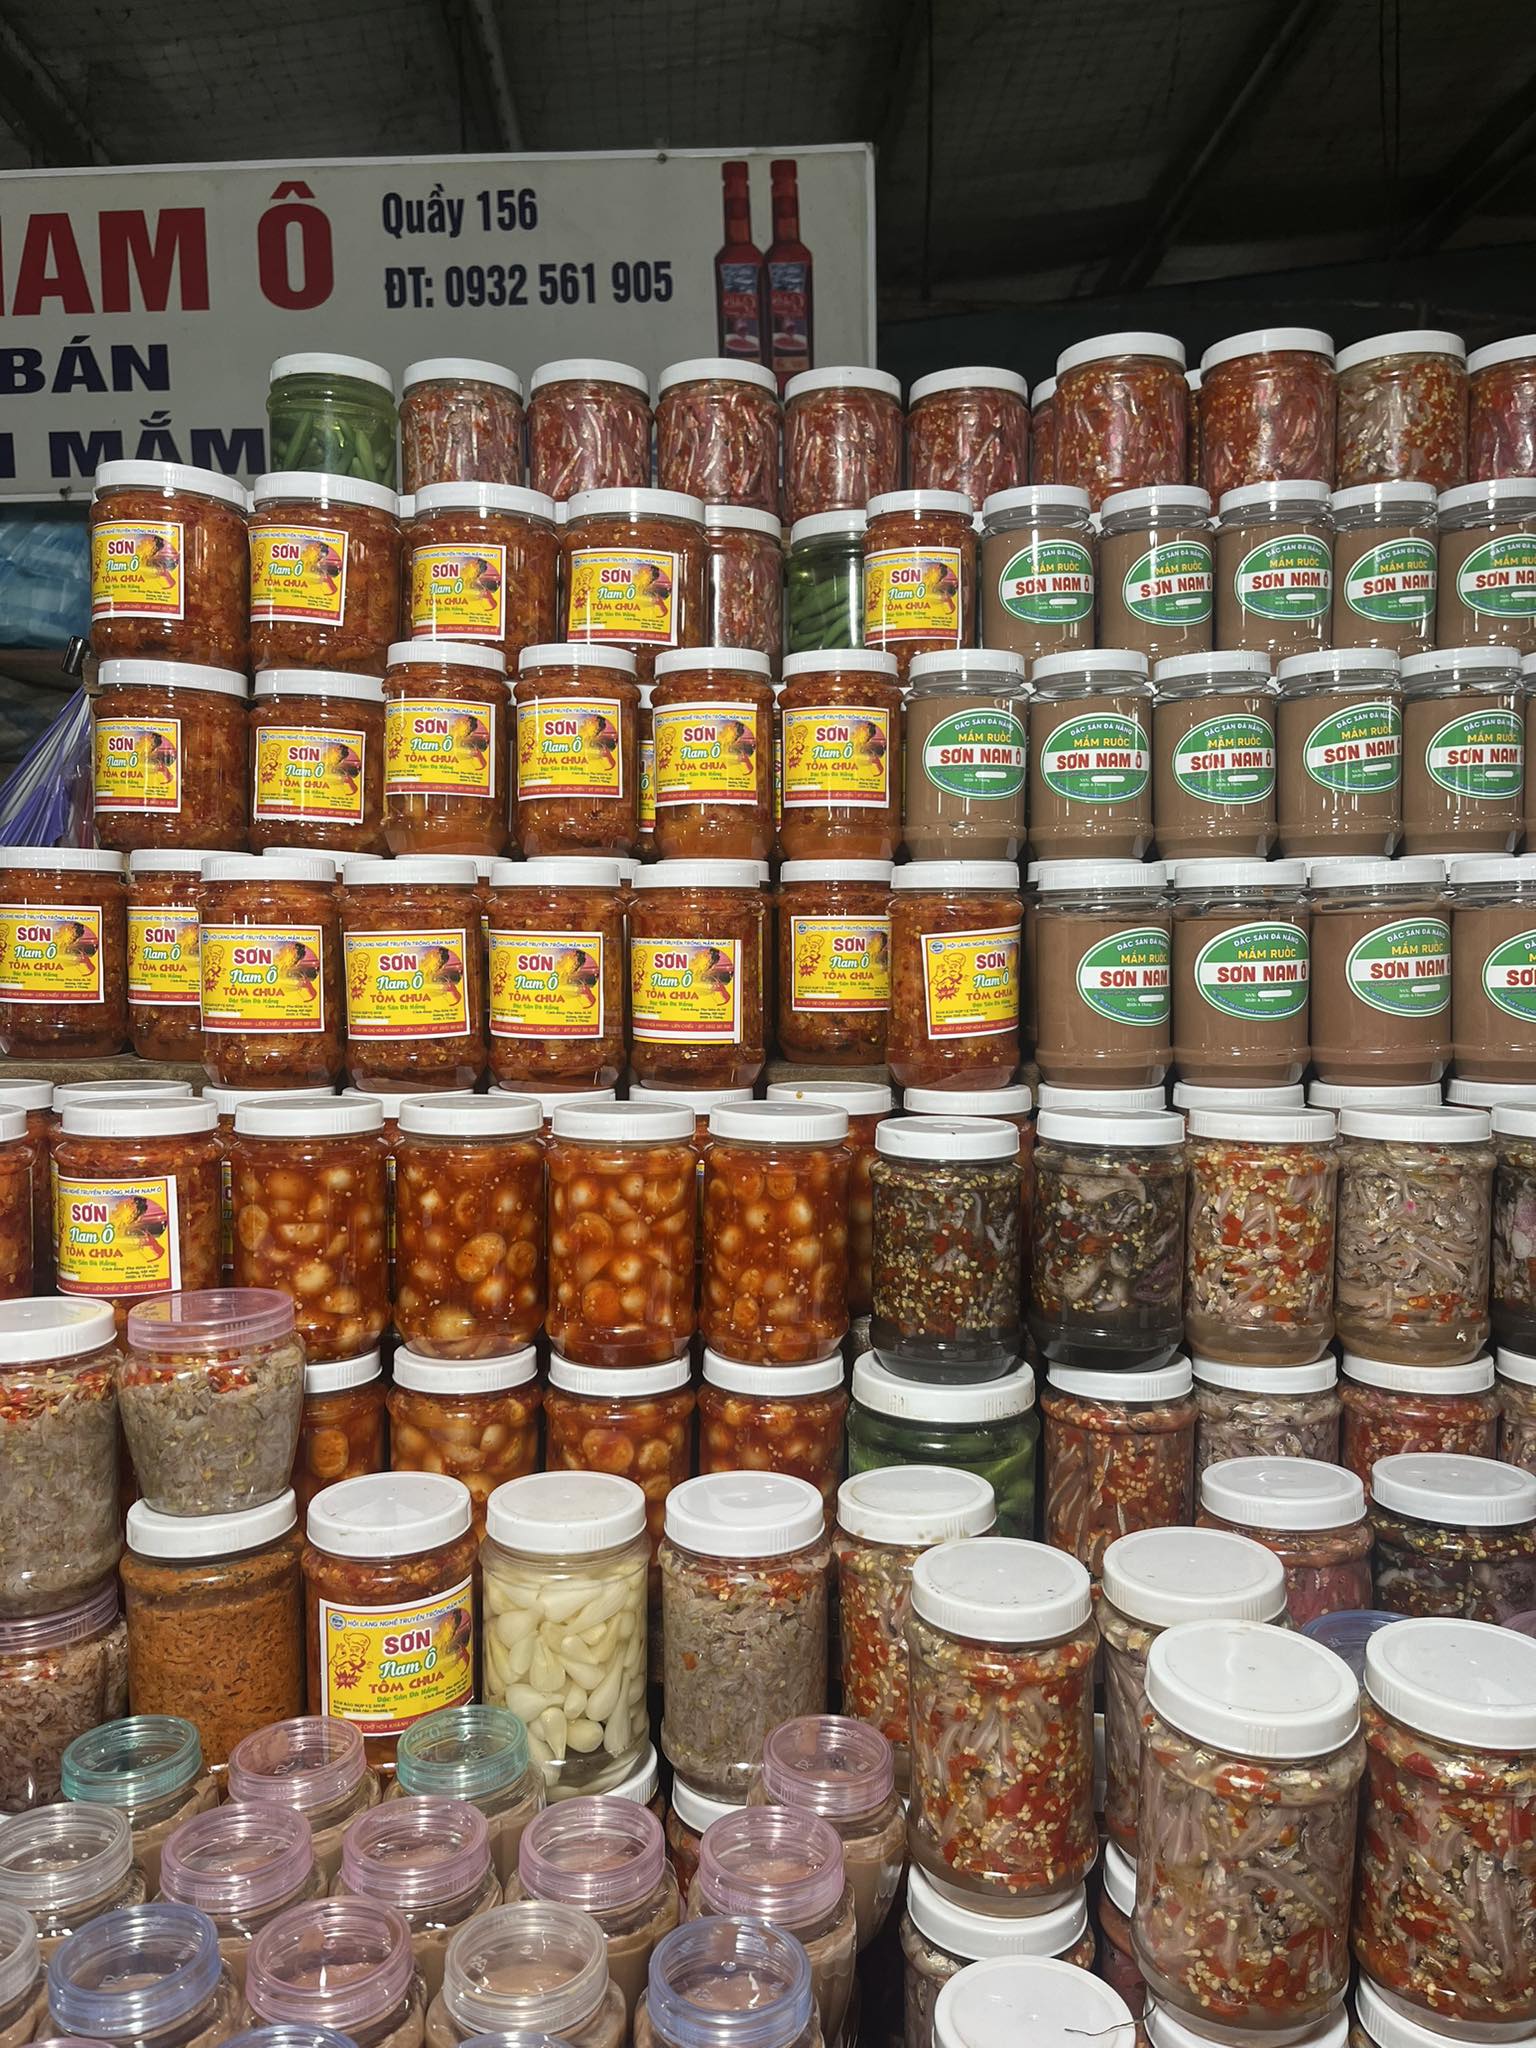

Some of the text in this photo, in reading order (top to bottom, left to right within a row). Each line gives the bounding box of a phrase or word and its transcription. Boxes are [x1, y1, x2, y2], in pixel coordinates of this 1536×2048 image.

[382, 184, 538, 239] Quầy 156
[0, 180, 334, 316] AM Ô
[385, 261, 673, 308] ĐT: 0932 561 905
[0, 336, 170, 394] BÁN
[49, 411, 267, 478] MẮM
[108, 540, 134, 555] SƠN
[272, 544, 299, 559] SƠN
[106, 560, 126, 572] Nam
[270, 563, 290, 576] Nam
[432, 564, 458, 578] SƠN
[601, 569, 630, 583] SƠN
[891, 568, 920, 584] SƠN
[1252, 572, 1284, 589] SƠN
[1291, 572, 1319, 586] NAM
[1476, 571, 1509, 588] SƠN
[430, 582, 450, 594] Nam
[1016, 580, 1046, 595] SƠN
[1053, 577, 1081, 592] NAM
[1141, 575, 1204, 597] SƠN NAM
[1363, 576, 1428, 594] SƠN NAM
[598, 587, 624, 599] Nam
[888, 587, 912, 599] Nam
[414, 719, 447, 733] SƠN
[545, 720, 576, 734] SƠN
[684, 726, 715, 740] SƠN
[816, 726, 848, 741] SƠN
[109, 737, 133, 750] SƠN
[411, 739, 439, 750] Nam
[542, 741, 569, 752] Nam
[289, 747, 320, 761] SƠN
[681, 747, 708, 758] Nam
[813, 746, 840, 758] Nam
[940, 747, 973, 764] SƠN
[980, 748, 1011, 763] NAM
[1325, 740, 1394, 763] SƠN NAM
[1448, 748, 1517, 764] SƠN NAM
[106, 756, 127, 766] Nam
[431, 755, 459, 763] CHUA
[561, 756, 588, 764] CHUA
[700, 762, 726, 770] CHUA
[831, 762, 858, 770] CHUA
[1057, 752, 1090, 770] SƠN
[1096, 753, 1130, 768] NAM
[1191, 754, 1224, 770] SƠN
[1232, 751, 1262, 767] NAM
[286, 764, 311, 776] Nam
[18, 926, 50, 941] SƠN
[146, 928, 175, 942] SƠN
[15, 946, 42, 958] Nam
[834, 938, 864, 952] SƠN
[143, 948, 168, 960] Nam
[234, 948, 271, 963] SƠN
[655, 953, 687, 968] SƠN
[977, 953, 1005, 969] SƠN
[34, 962, 64, 970] CHUA
[380, 954, 416, 970] SƠN
[518, 955, 552, 970] SƠN
[830, 958, 857, 968] Nam
[1370, 959, 1444, 978] SƠN NAM
[231, 970, 262, 983] Nam
[651, 975, 679, 986] Nam
[1100, 969, 1167, 986] SƠN NAM
[1217, 966, 1255, 982] SƠN
[1263, 965, 1297, 981] NAM
[378, 977, 408, 989] Nam
[515, 977, 543, 989] Nam
[974, 975, 1000, 987] Nam
[252, 988, 284, 996] CHUA
[400, 993, 431, 1002] CHUA
[535, 994, 564, 1002] CHUA
[670, 990, 699, 999] CHUA
[72, 1204, 106, 1222] SƠN
[70, 1228, 98, 1242] Nam
[89, 1249, 123, 1257] CHUA
[385, 1629, 430, 1654] SƠN
[380, 1661, 420, 1678] Nam
[409, 1672, 444, 1686] CHUA
